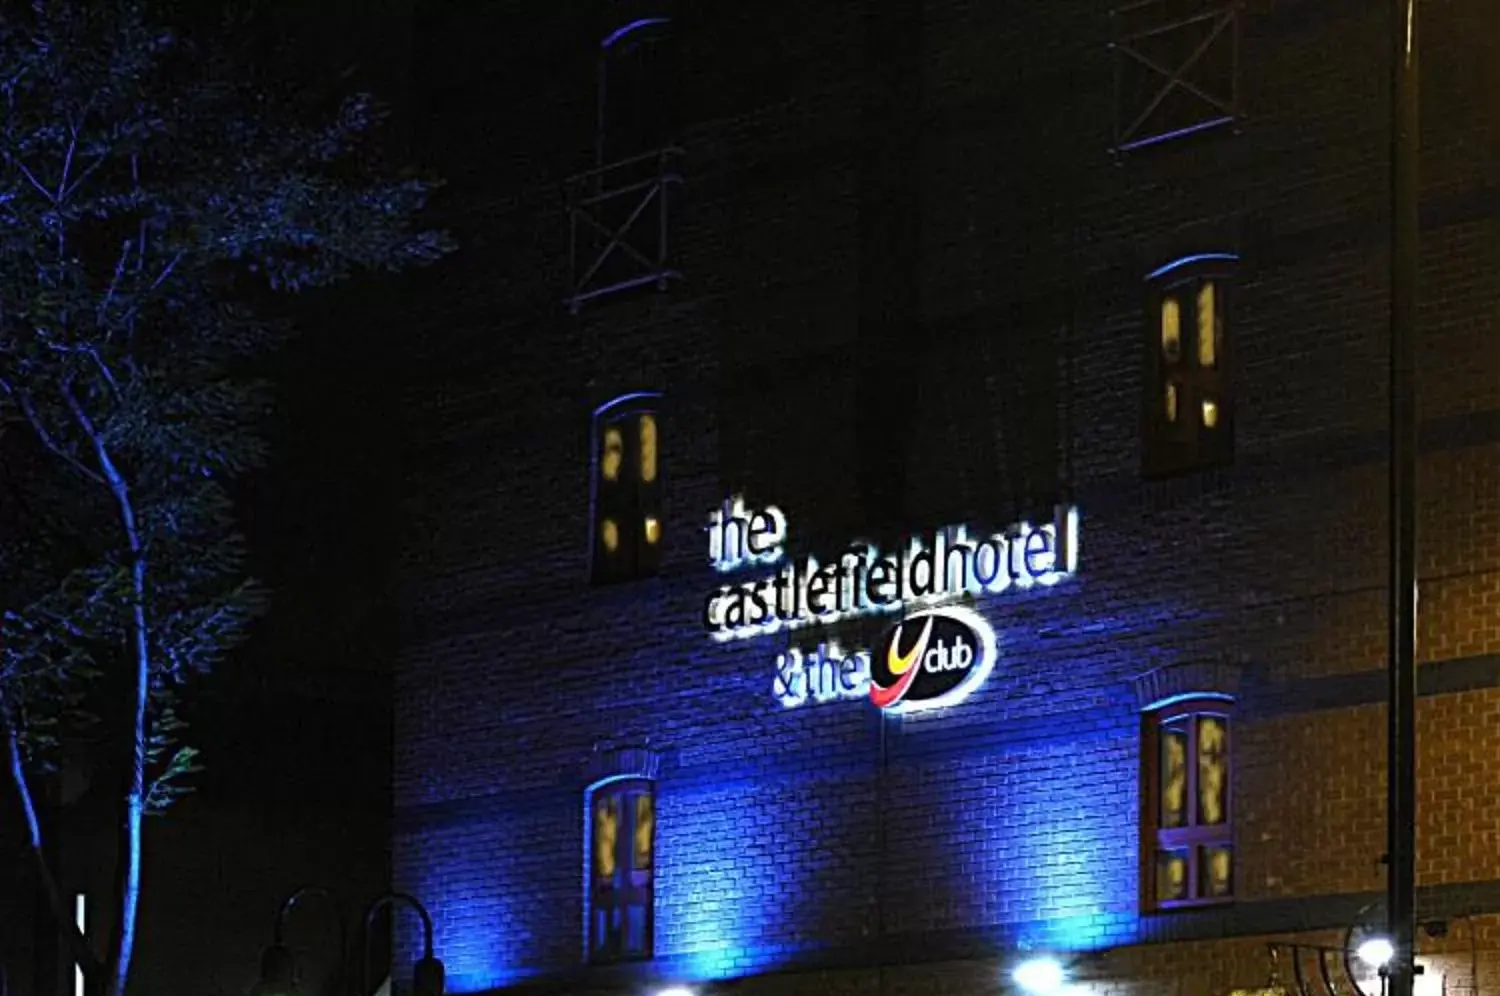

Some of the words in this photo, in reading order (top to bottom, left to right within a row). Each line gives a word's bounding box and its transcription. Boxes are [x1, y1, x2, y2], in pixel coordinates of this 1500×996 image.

[706, 496, 786, 568] the
[774, 650, 804, 706] &
[804, 641, 870, 700] the
[924, 641, 973, 673] club
